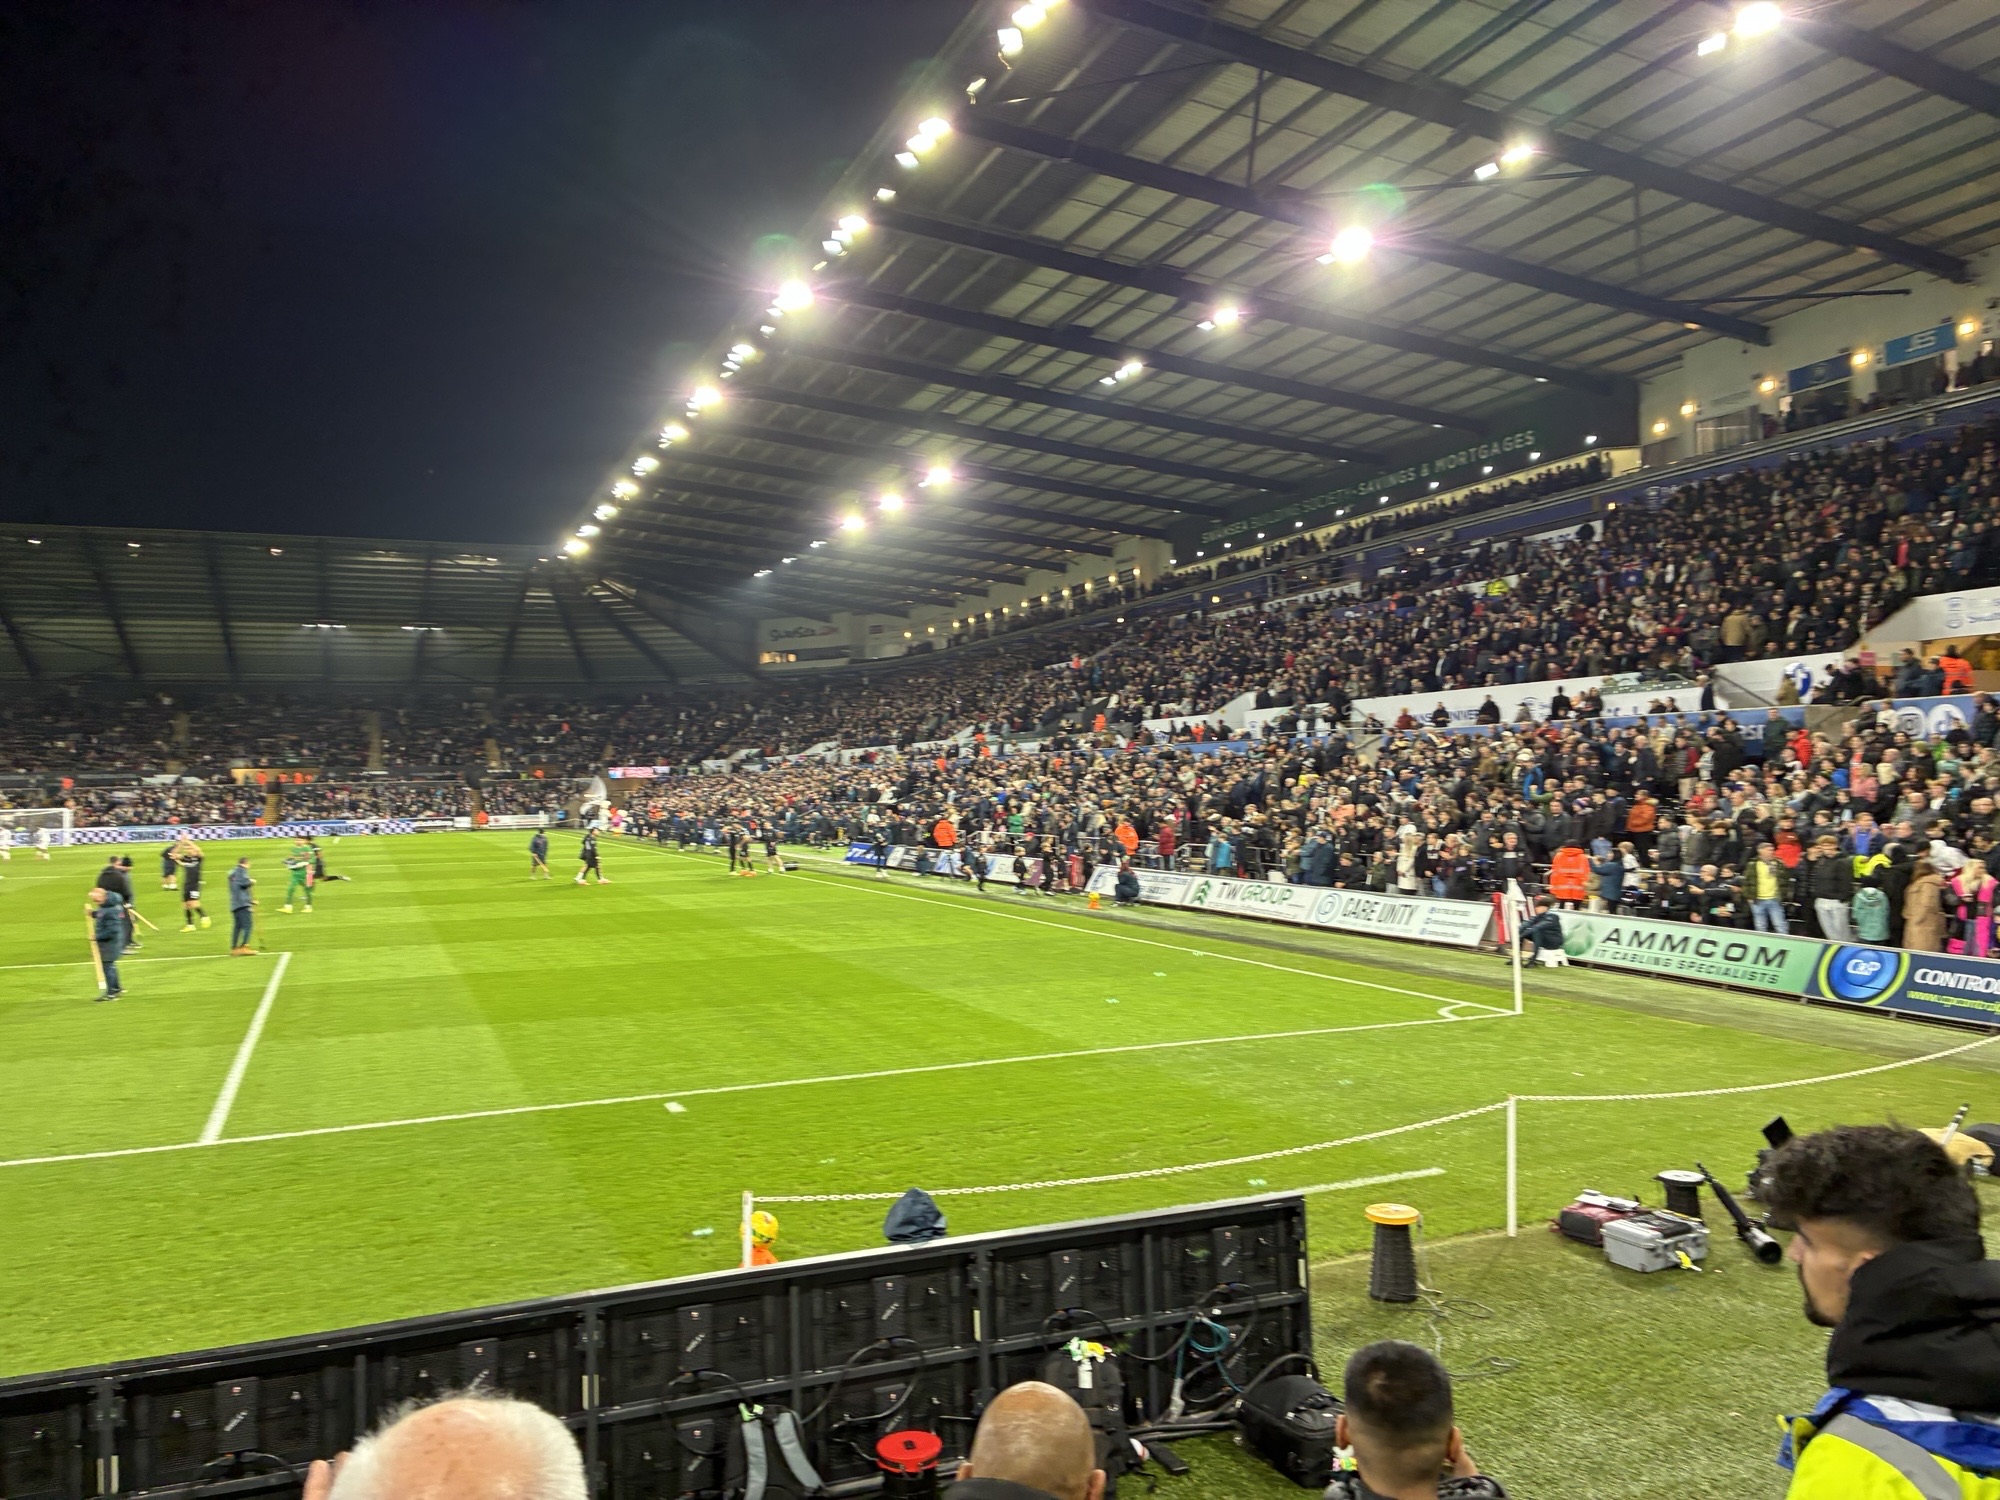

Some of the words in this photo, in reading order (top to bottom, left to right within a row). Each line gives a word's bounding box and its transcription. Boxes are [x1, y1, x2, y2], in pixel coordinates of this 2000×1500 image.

[1357, 466, 1417, 496] SAVINGS
[1434, 430, 1536, 473] MORTGAGES
[1241, 884, 1295, 905] GROUP
[1341, 896, 1380, 922] CARE
[1377, 902, 1420, 926] UNITY
[1592, 948, 1608, 959] IT
[1611, 950, 1673, 968] CABLING
[1677, 958, 1781, 985] SPECIALISTS
[1600, 927, 1790, 969] AMMCOM
